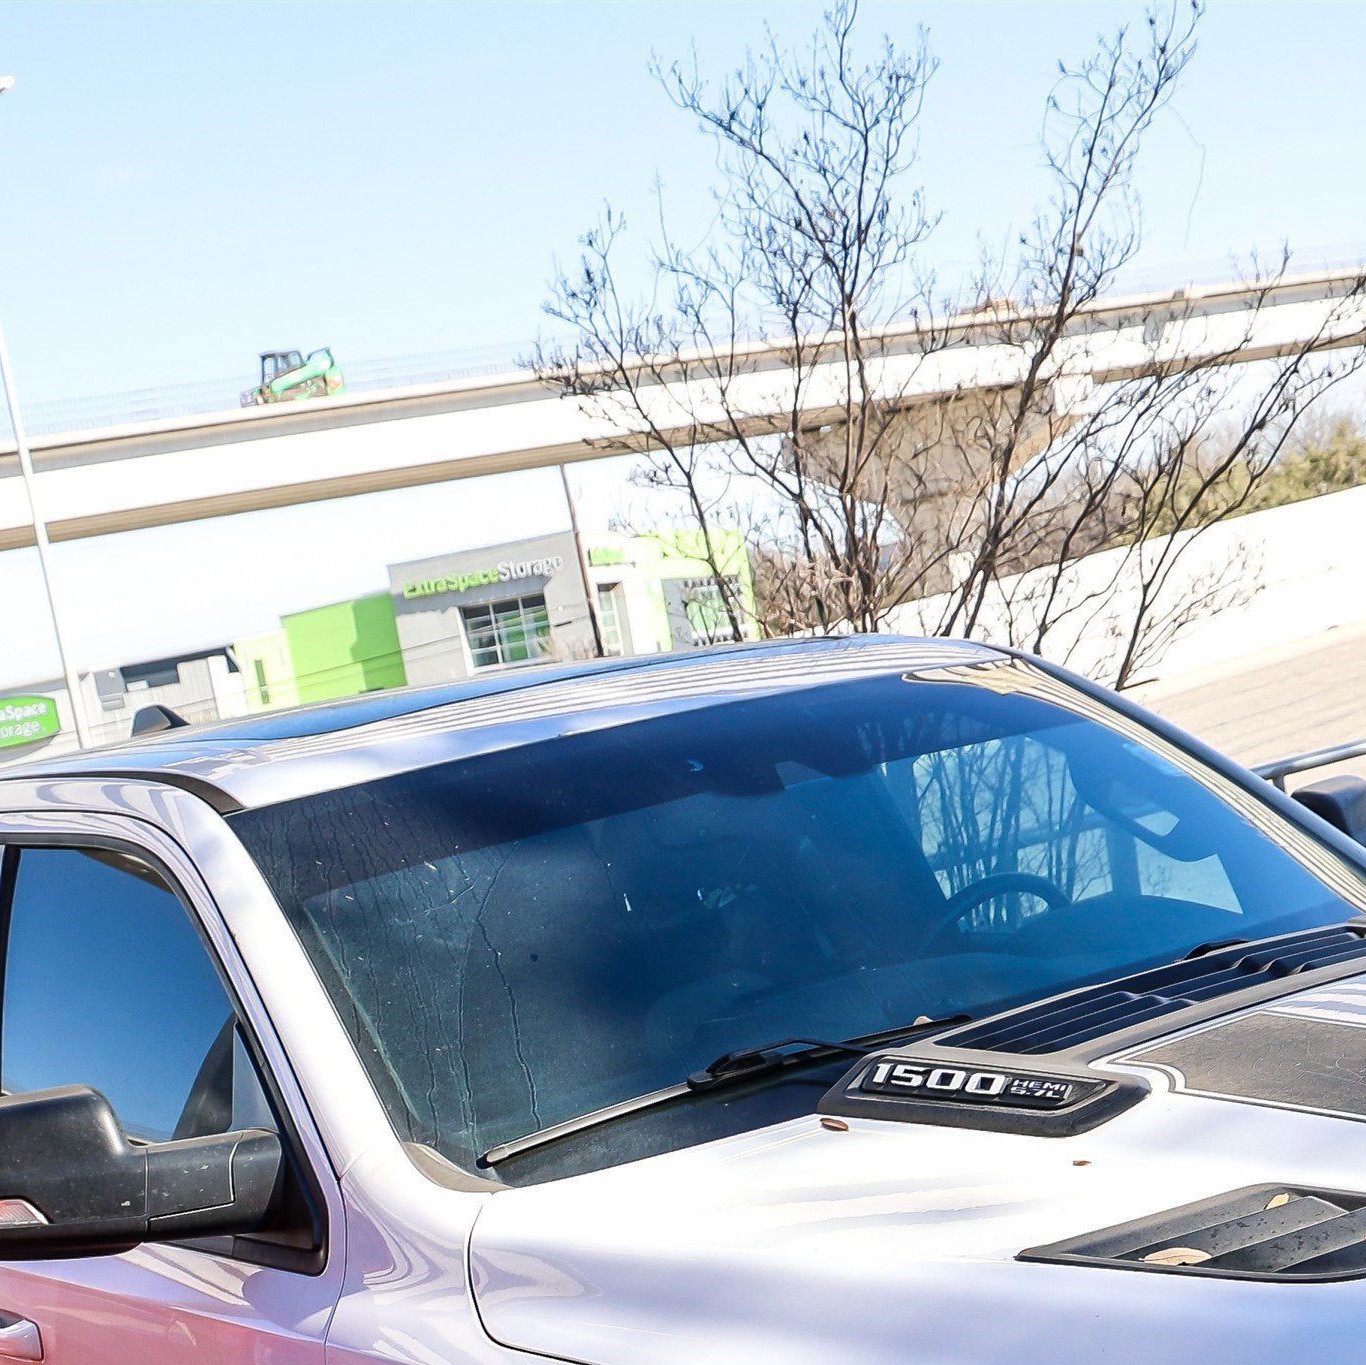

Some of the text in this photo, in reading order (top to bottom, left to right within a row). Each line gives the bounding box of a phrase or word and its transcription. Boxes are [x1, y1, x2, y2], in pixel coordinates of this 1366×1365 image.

[873, 1062, 1006, 1095] 1500
[1011, 1079, 1067, 1092] HEMI
[1009, 1087, 1066, 1099] 5.7L
